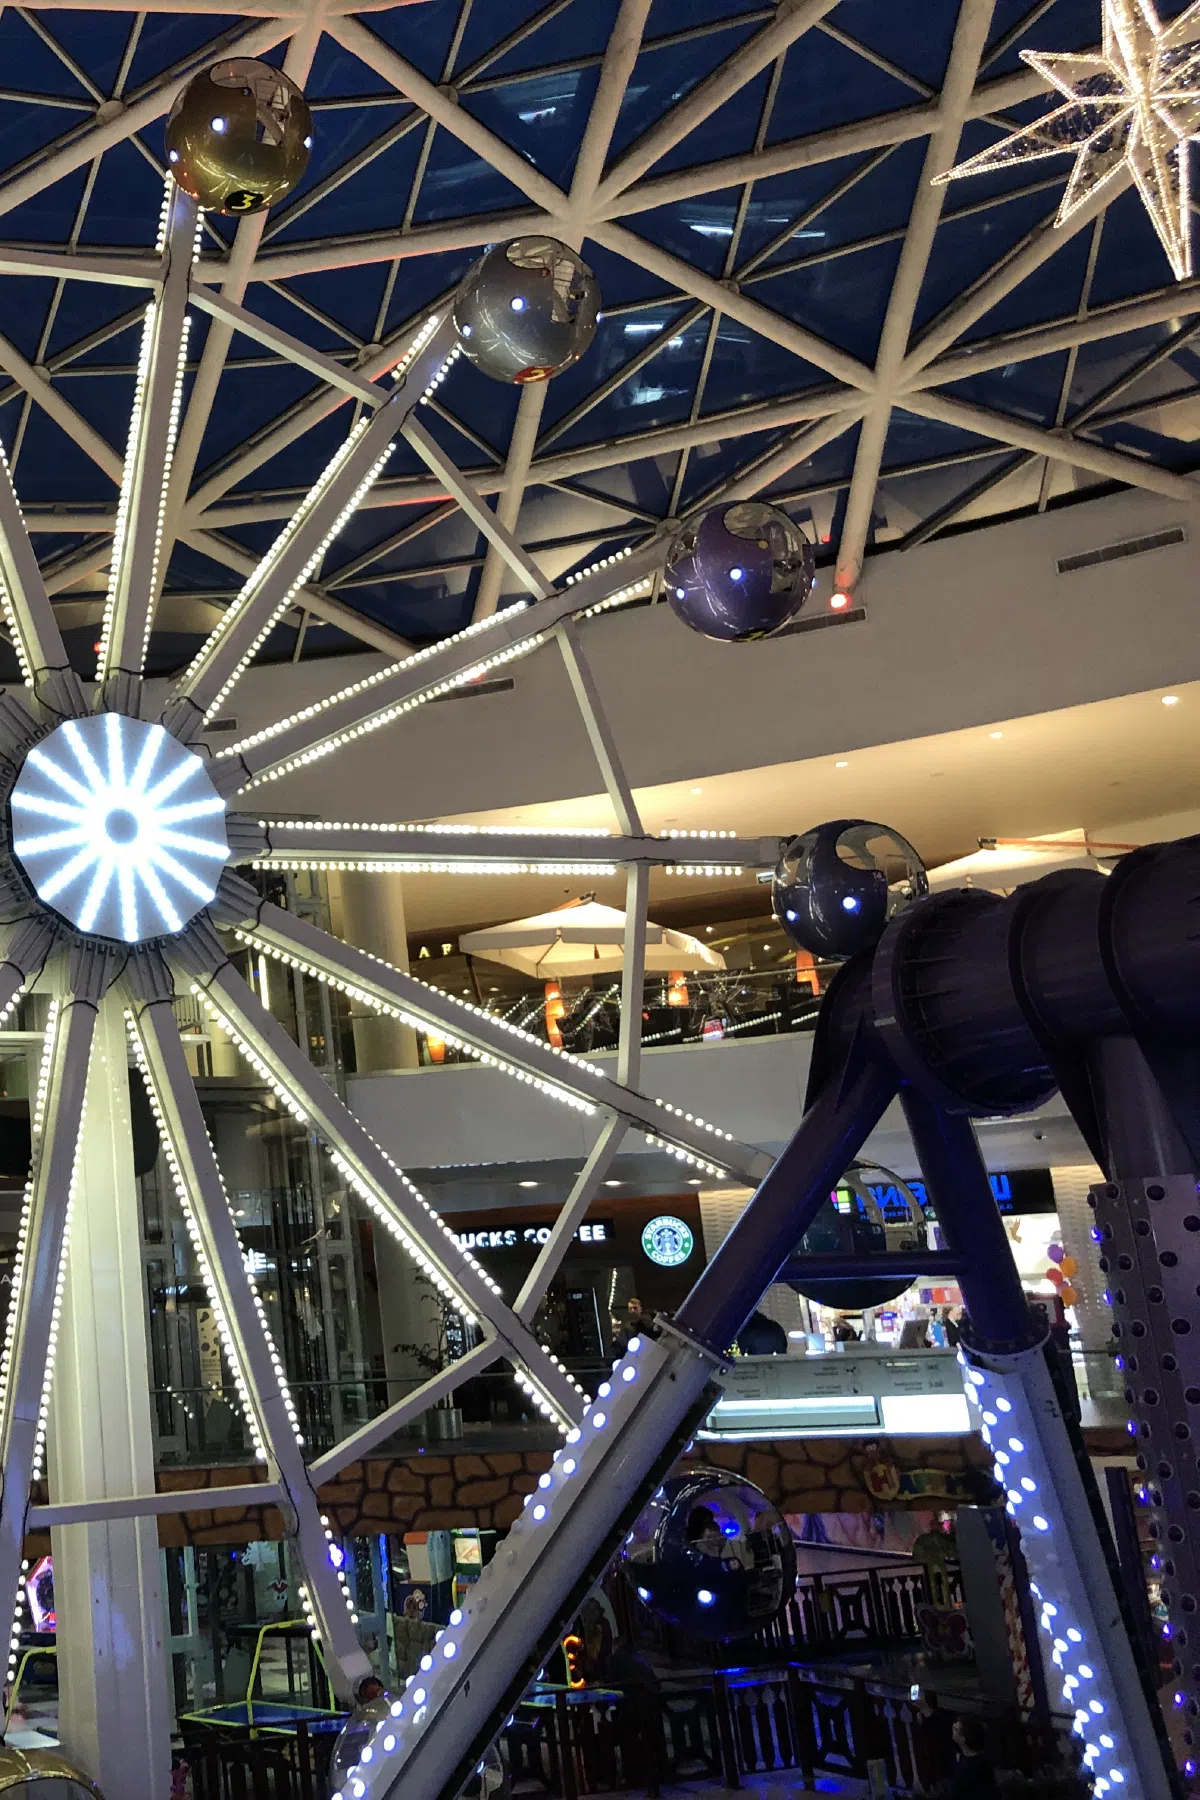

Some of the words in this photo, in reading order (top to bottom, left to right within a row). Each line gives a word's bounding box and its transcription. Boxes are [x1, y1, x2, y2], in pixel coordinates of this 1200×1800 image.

[232, 194, 256, 209] 3
[524, 1225, 606, 1245] COEE
[645, 1218, 690, 1239] STARBUCKS
[651, 1250, 686, 1264] COFFEE
